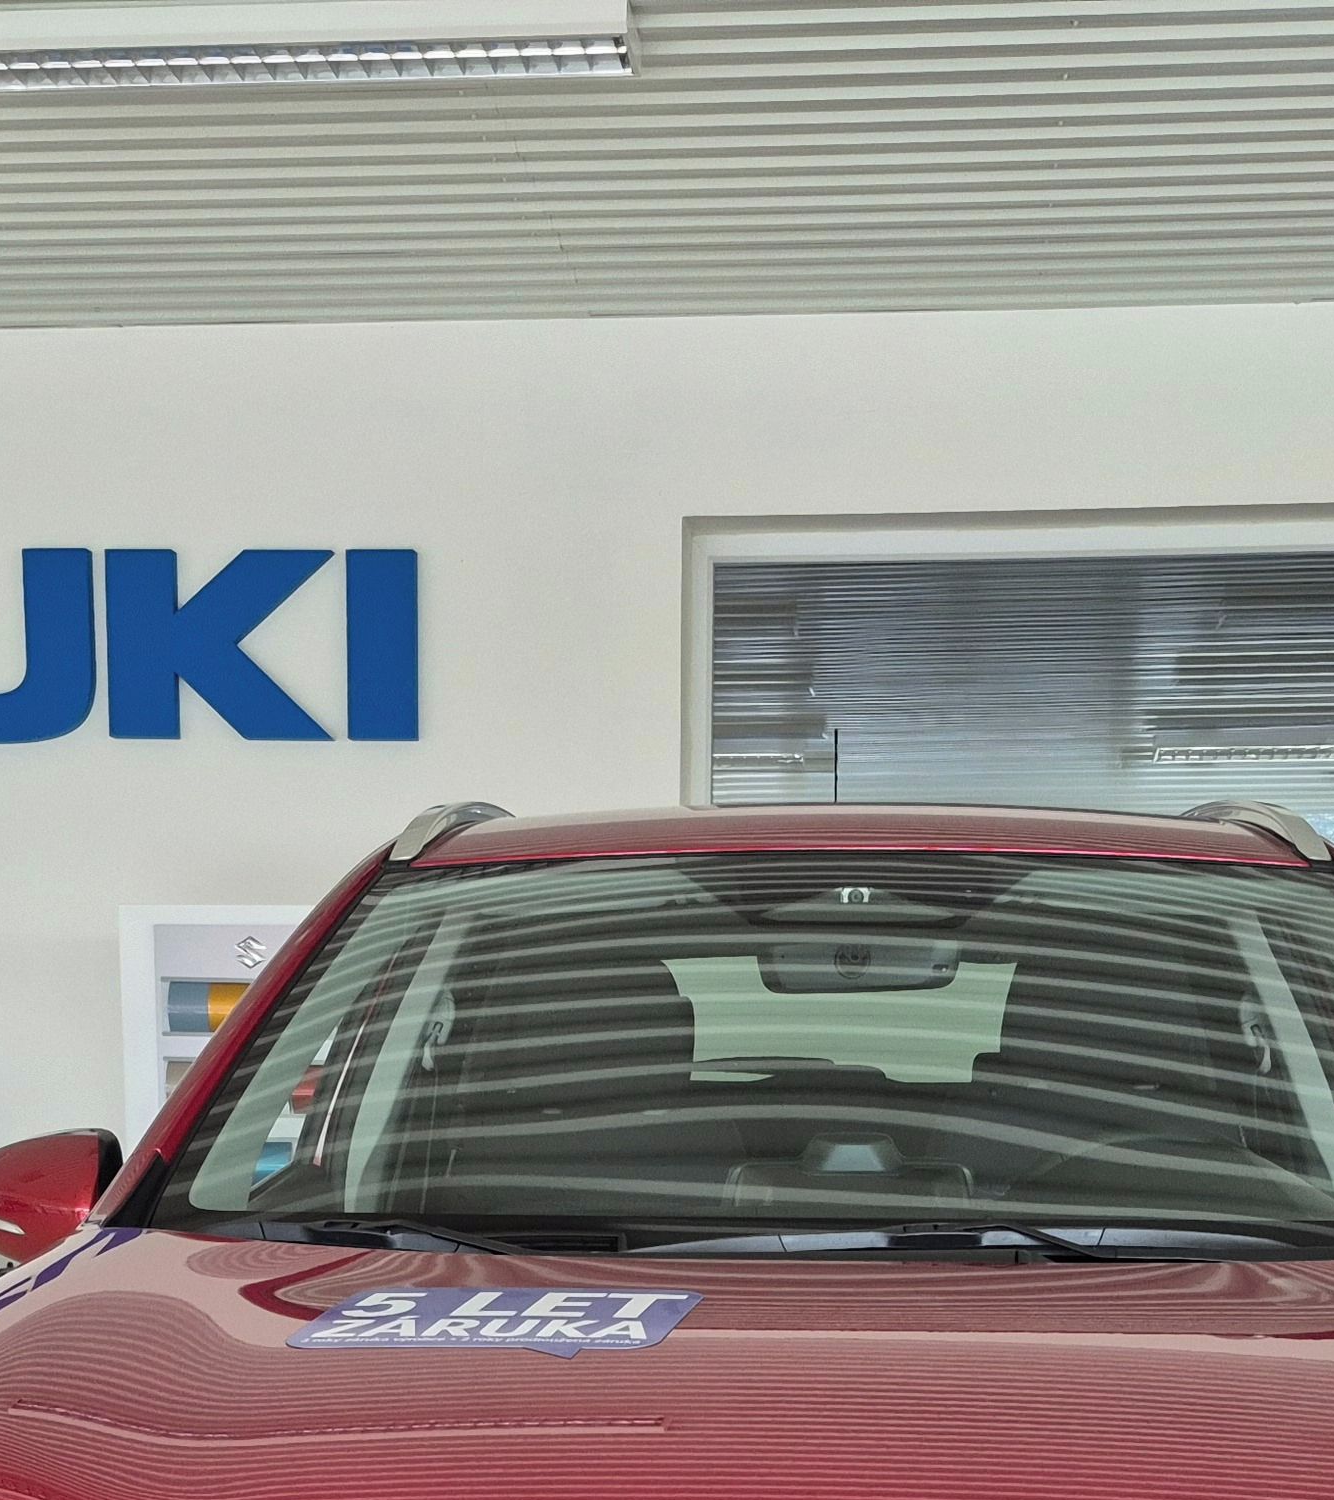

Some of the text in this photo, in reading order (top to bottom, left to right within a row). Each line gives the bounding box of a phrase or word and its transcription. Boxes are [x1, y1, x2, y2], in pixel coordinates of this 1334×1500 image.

[341, 1291, 689, 1319] 5 LET
[310, 1315, 648, 1340] ZÁRUKA
